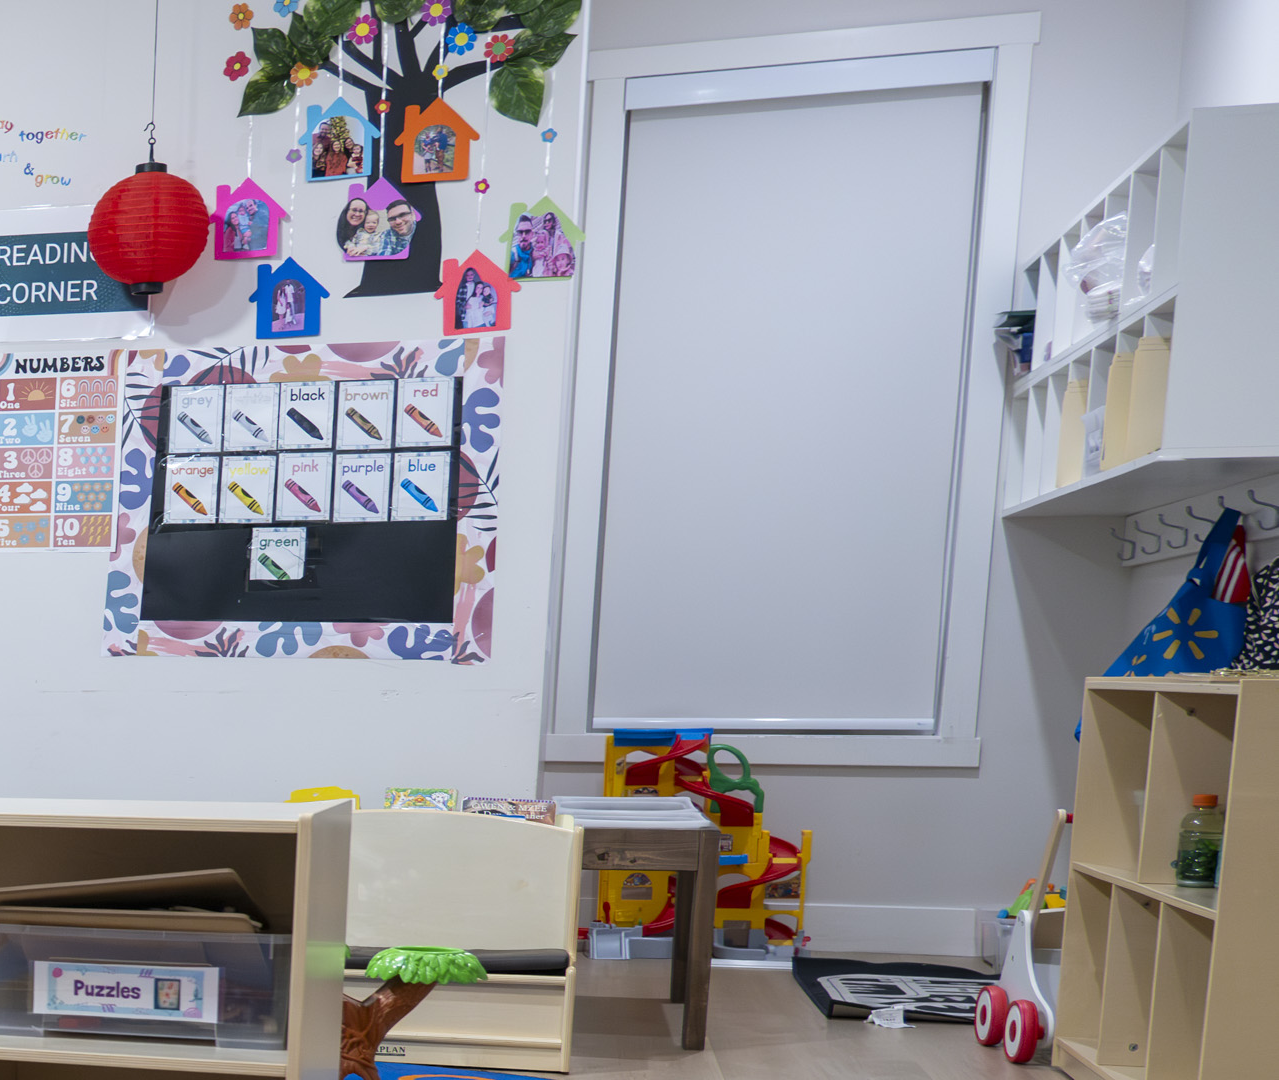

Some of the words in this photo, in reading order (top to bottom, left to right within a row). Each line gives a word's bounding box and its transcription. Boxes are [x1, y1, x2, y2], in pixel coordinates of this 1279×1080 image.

[19, 127, 87, 145] together
[24, 163, 34, 176] &
[34, 174, 72, 188] grow
[14, 356, 105, 374] NUMBERS
[6, 382, 16, 401] 1
[60, 379, 76, 398] 6
[290, 387, 325, 402] black
[344, 387, 388, 402] brown
[412, 384, 439, 399] red
[60, 399, 78, 408] Six
[182, 396, 214, 409] grey
[2, 418, 17, 436] 2
[60, 414, 74, 433] 7
[58, 434, 91, 443] Seven
[4, 450, 18, 469] 3
[58, 448, 74, 466] 8
[57, 467, 86, 476] Eight
[172, 466, 214, 478] orange
[229, 462, 270, 479] yellow
[292, 460, 319, 474] pink
[342, 460, 384, 475] purple
[408, 458, 437, 472] blue
[56, 483, 71, 501] 9
[56, 503, 80, 511] Nine
[55, 518, 79, 536] 10
[56, 538, 76, 546] Ten
[259, 536, 299, 551] green
[472, 802, 507, 811] OWEN
[518, 804, 548, 812] MZEE
[73, 978, 141, 1000] Puzzles
